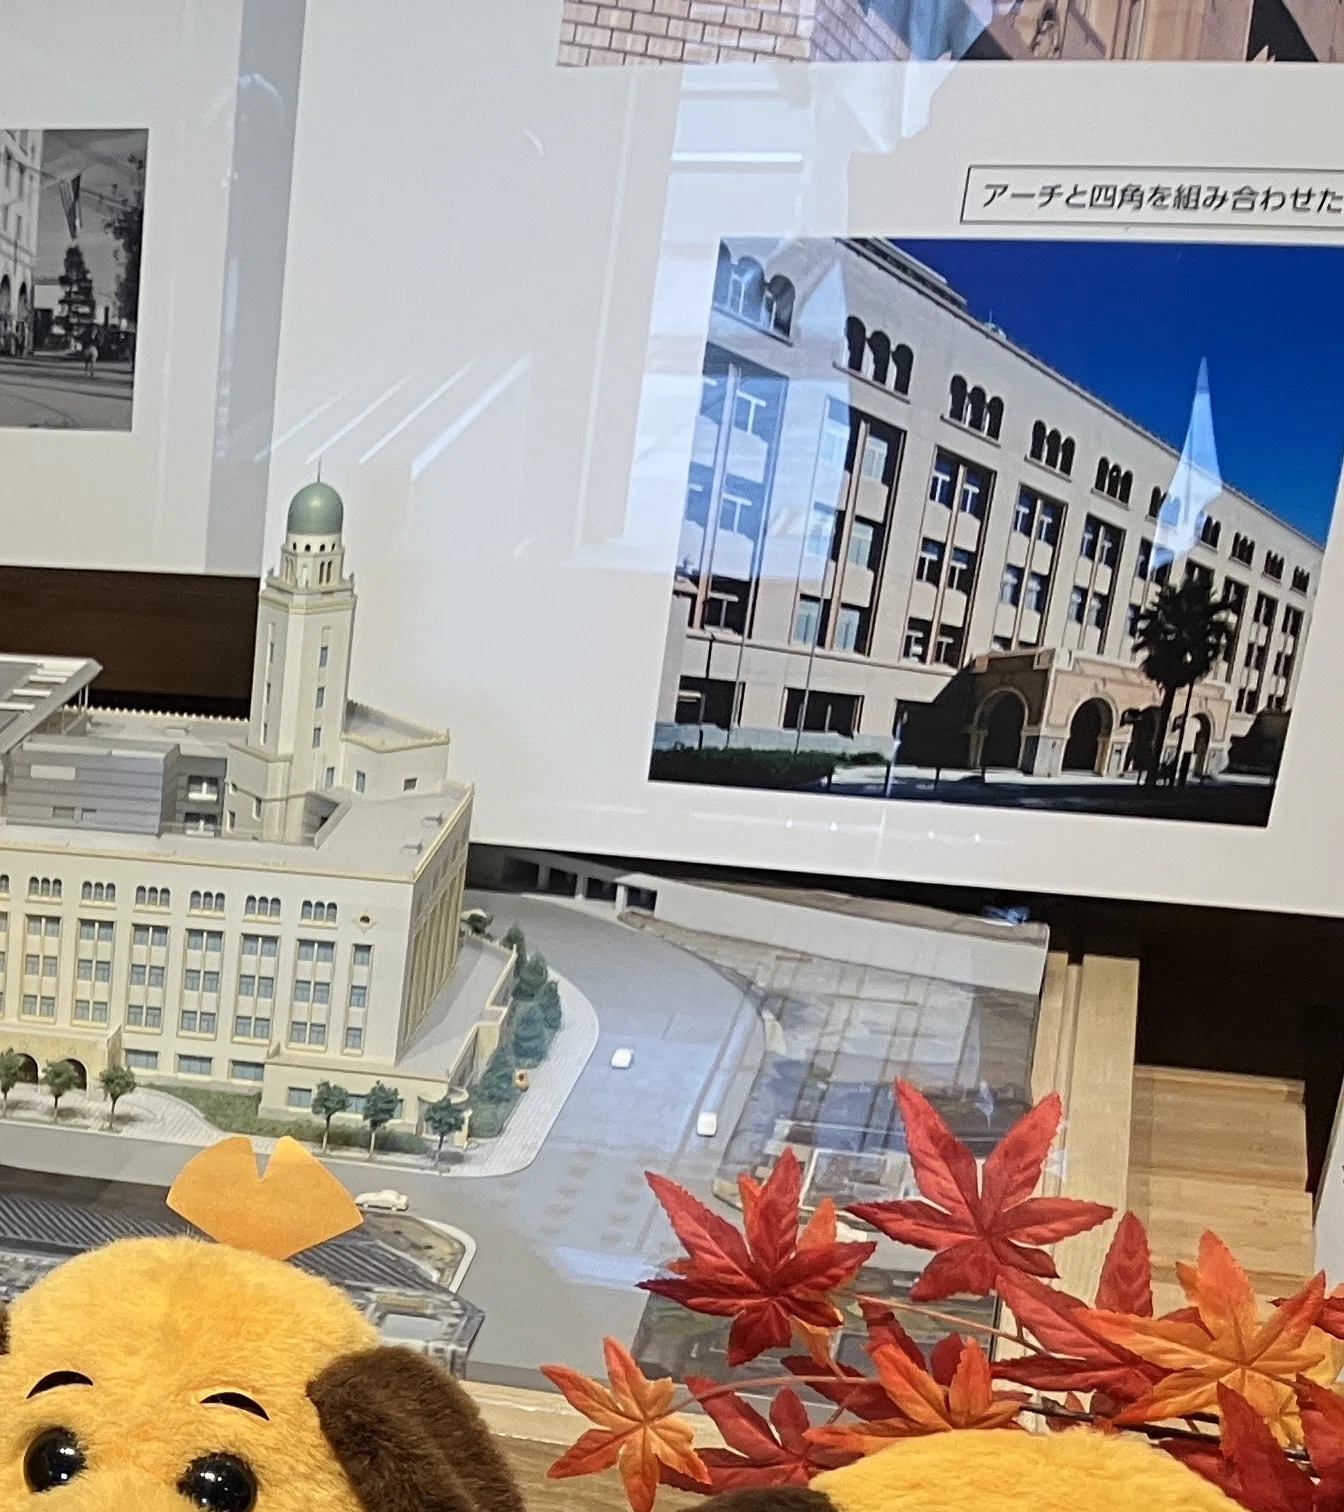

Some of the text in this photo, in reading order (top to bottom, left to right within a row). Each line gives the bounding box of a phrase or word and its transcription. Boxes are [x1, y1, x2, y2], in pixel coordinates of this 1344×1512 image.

[982, 183, 1344, 214] アーチと四角を組み合わせた
